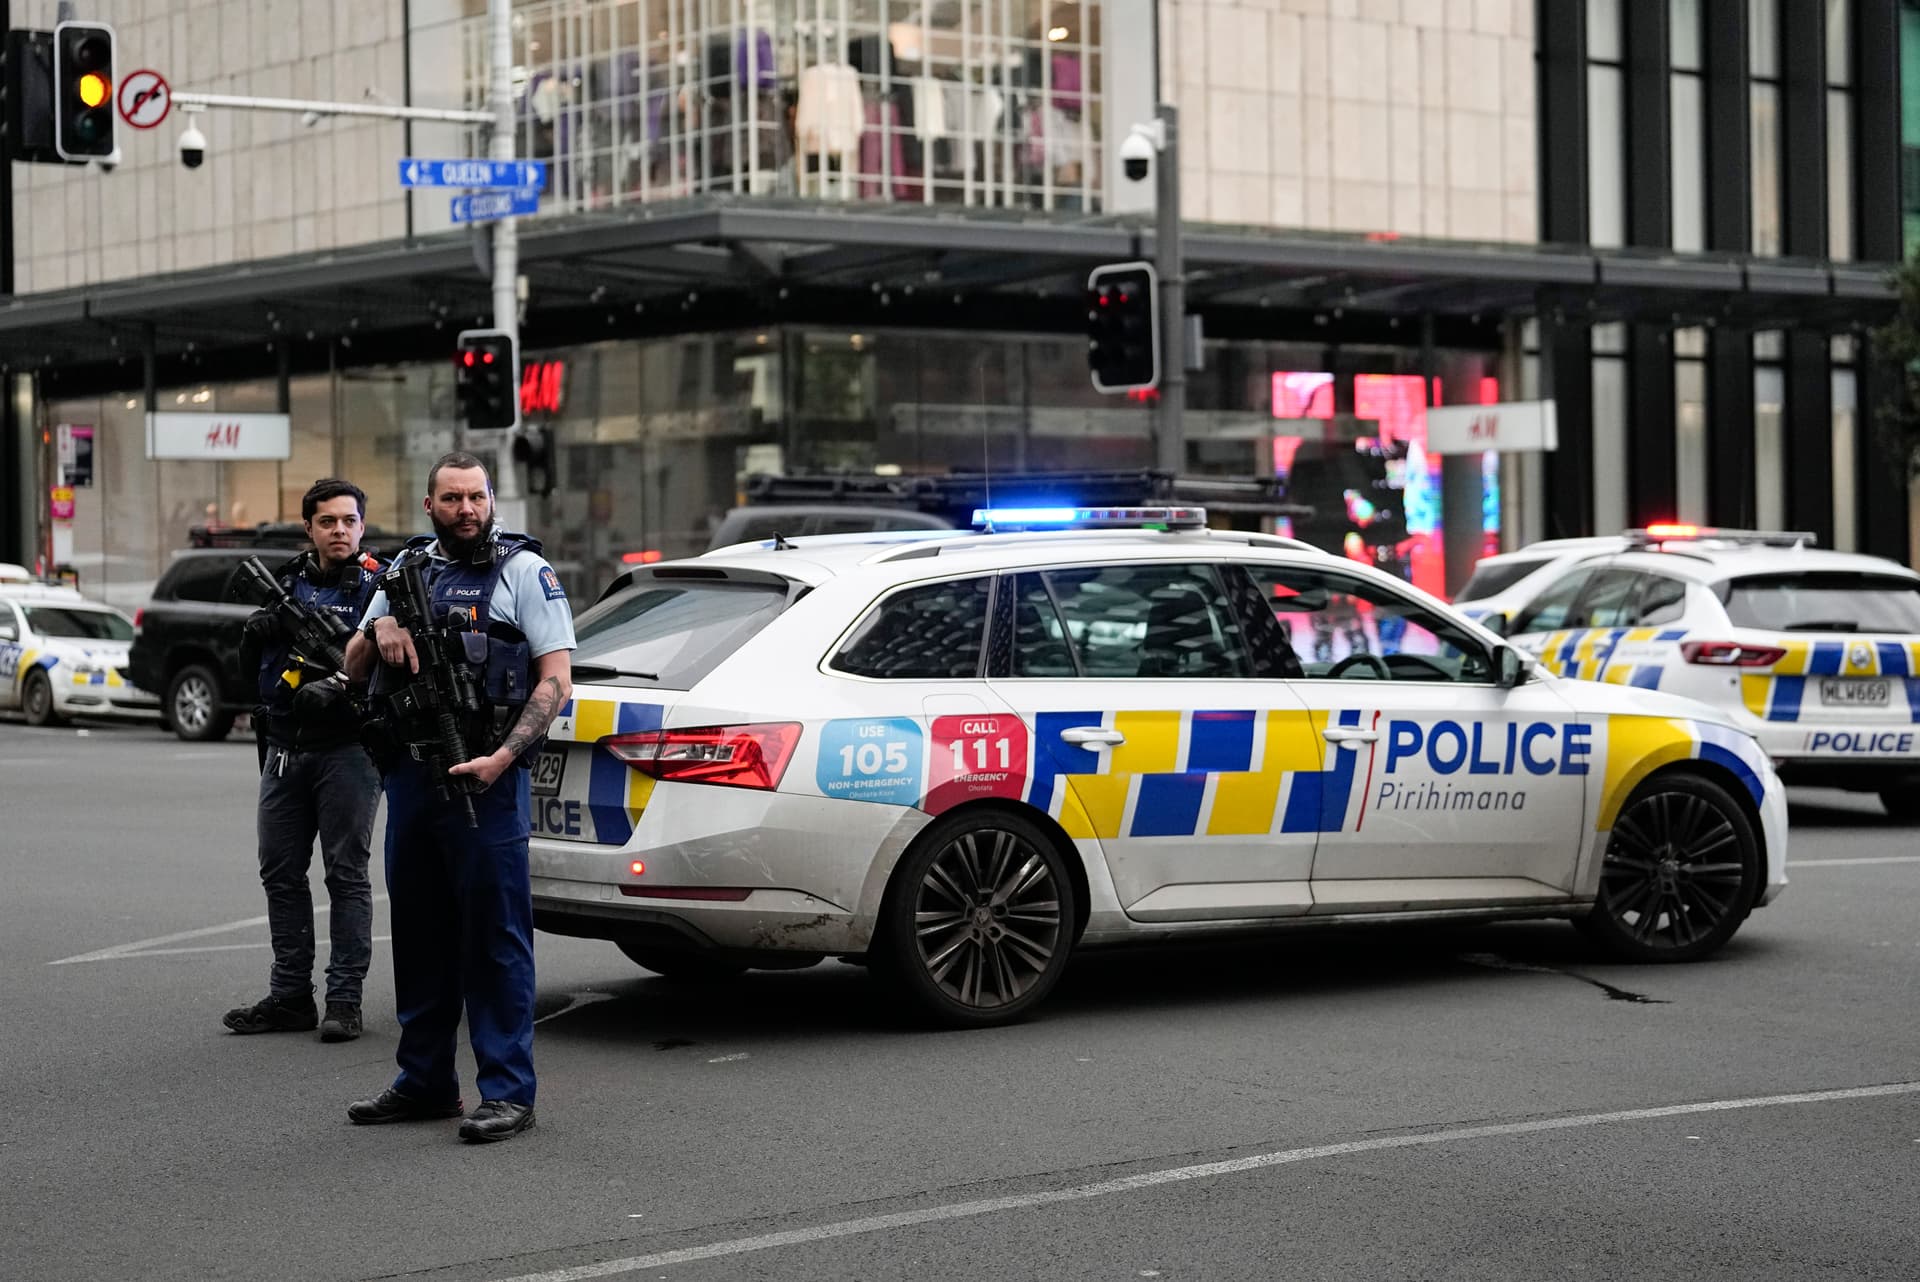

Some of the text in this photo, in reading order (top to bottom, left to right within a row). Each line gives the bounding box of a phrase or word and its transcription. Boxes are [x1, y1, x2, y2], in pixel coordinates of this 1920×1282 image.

[442, 162, 492, 184] QUEEN
[859, 725, 885, 738] USE
[963, 722, 996, 735] CALL
[949, 738, 1010, 770] 111
[1385, 719, 1592, 776] POLICE
[1811, 732, 1914, 752] POLICE
[530, 755, 560, 784] 429
[839, 741, 908, 777] 105
[828, 777, 913, 790] NON-EMERGENCY
[954, 772, 1008, 783] EMERGENCY
[1376, 781, 1527, 810] Pirihimana
[530, 797, 581, 835] ICE
